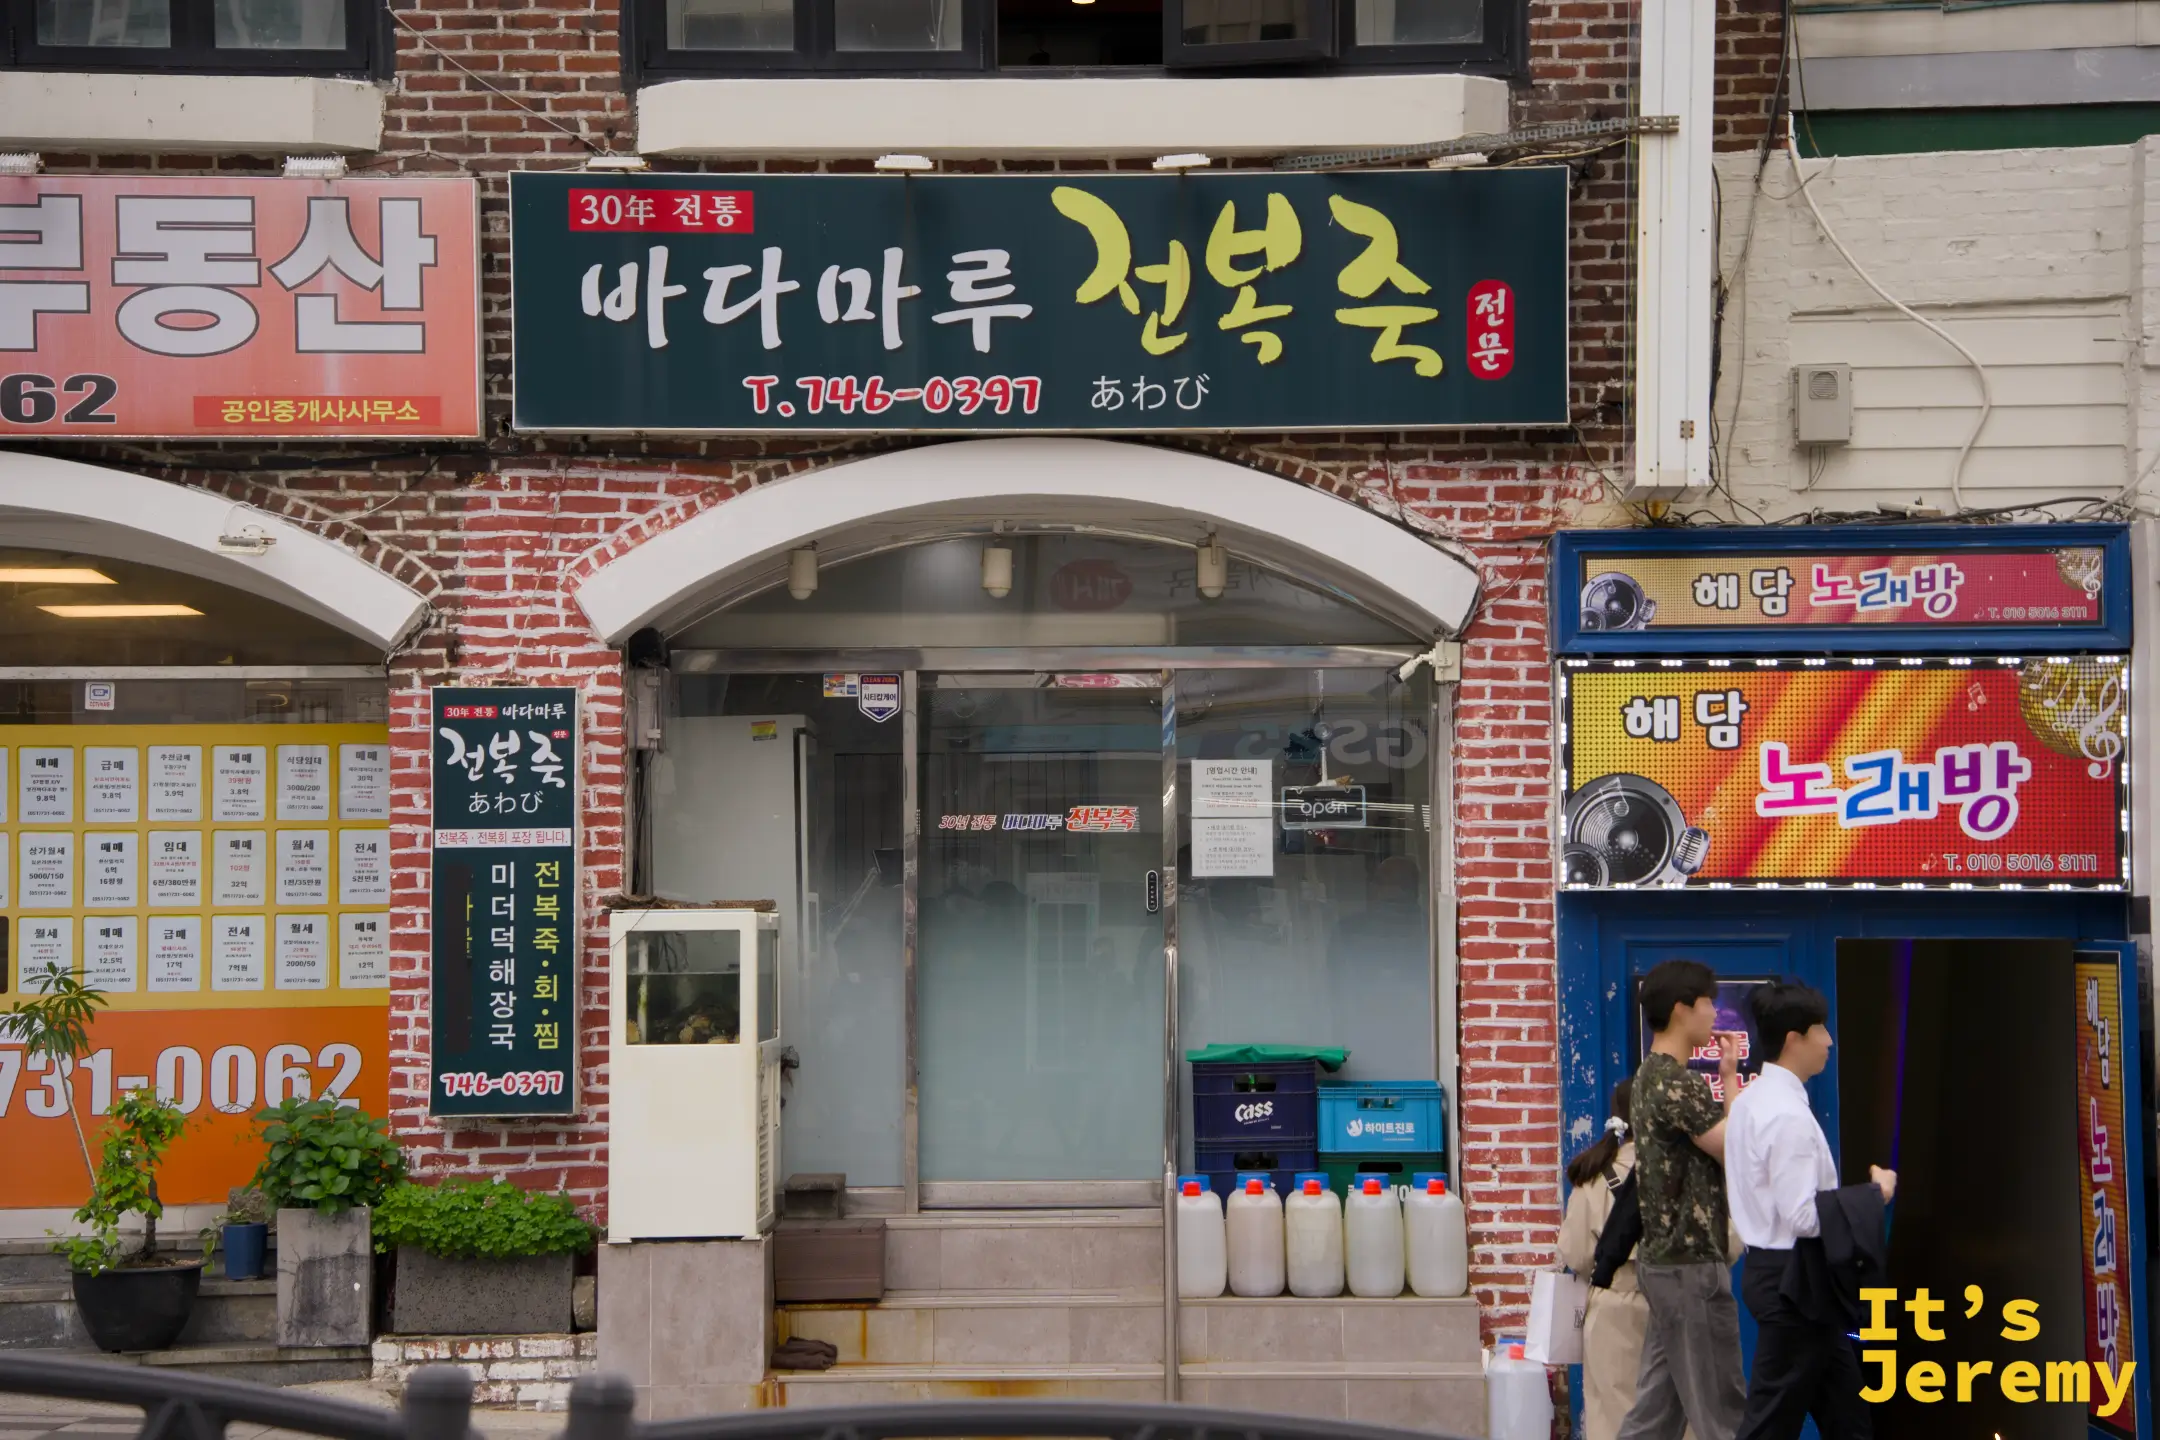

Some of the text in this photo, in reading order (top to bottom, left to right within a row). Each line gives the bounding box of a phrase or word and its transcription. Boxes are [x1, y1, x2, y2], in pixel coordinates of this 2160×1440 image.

[579, 193, 743, 228] 30年 전통
[581, 186, 1443, 377] 바다마루 전복죽
[1472, 288, 1509, 371] 전문
[743, 375, 1041, 415] T.746-0397
[1091, 373, 1210, 411] あわび
[220, 399, 421, 423] 공인중개사사무소
[1809, 563, 1964, 618] 노래방
[2002, 606, 2026, 619] 010
[2028, 606, 2059, 619] 5016
[2061, 606, 2088, 619] 3111
[473, 707, 496, 718] 전통
[502, 703, 567, 720] 바다마루
[230, 753, 252, 763] 매매
[439, 727, 566, 788] 전복죽
[101, 761, 124, 770] 급매
[1755, 740, 2031, 840] 노래방
[468, 791, 544, 814] あわび
[1300, 800, 1348, 818] open
[1064, 806, 1138, 832] 전복죽
[230, 840, 252, 850] 매매
[292, 840, 314, 850] 월세
[511, 831, 532, 844] 포장
[29, 847, 65, 855] 상가월세
[101, 842, 123, 852] 매매
[164, 842, 186, 852] 임대
[355, 843, 376, 853] 전세
[1943, 853, 2098, 871] T. 010 5016 3111
[35, 928, 57, 938] 월세
[100, 928, 122, 938] 매매
[164, 929, 186, 940] 급매
[228, 926, 250, 937] 전세
[291, 923, 312, 933] 월세
[355, 922, 376, 932] 매매
[488, 861, 517, 1051] 미더덕해장국
[440, 1070, 564, 1096] 746-0397
[1234, 1100, 1274, 1123] Cass
[1365, 1121, 1415, 1135] 하이트진로
